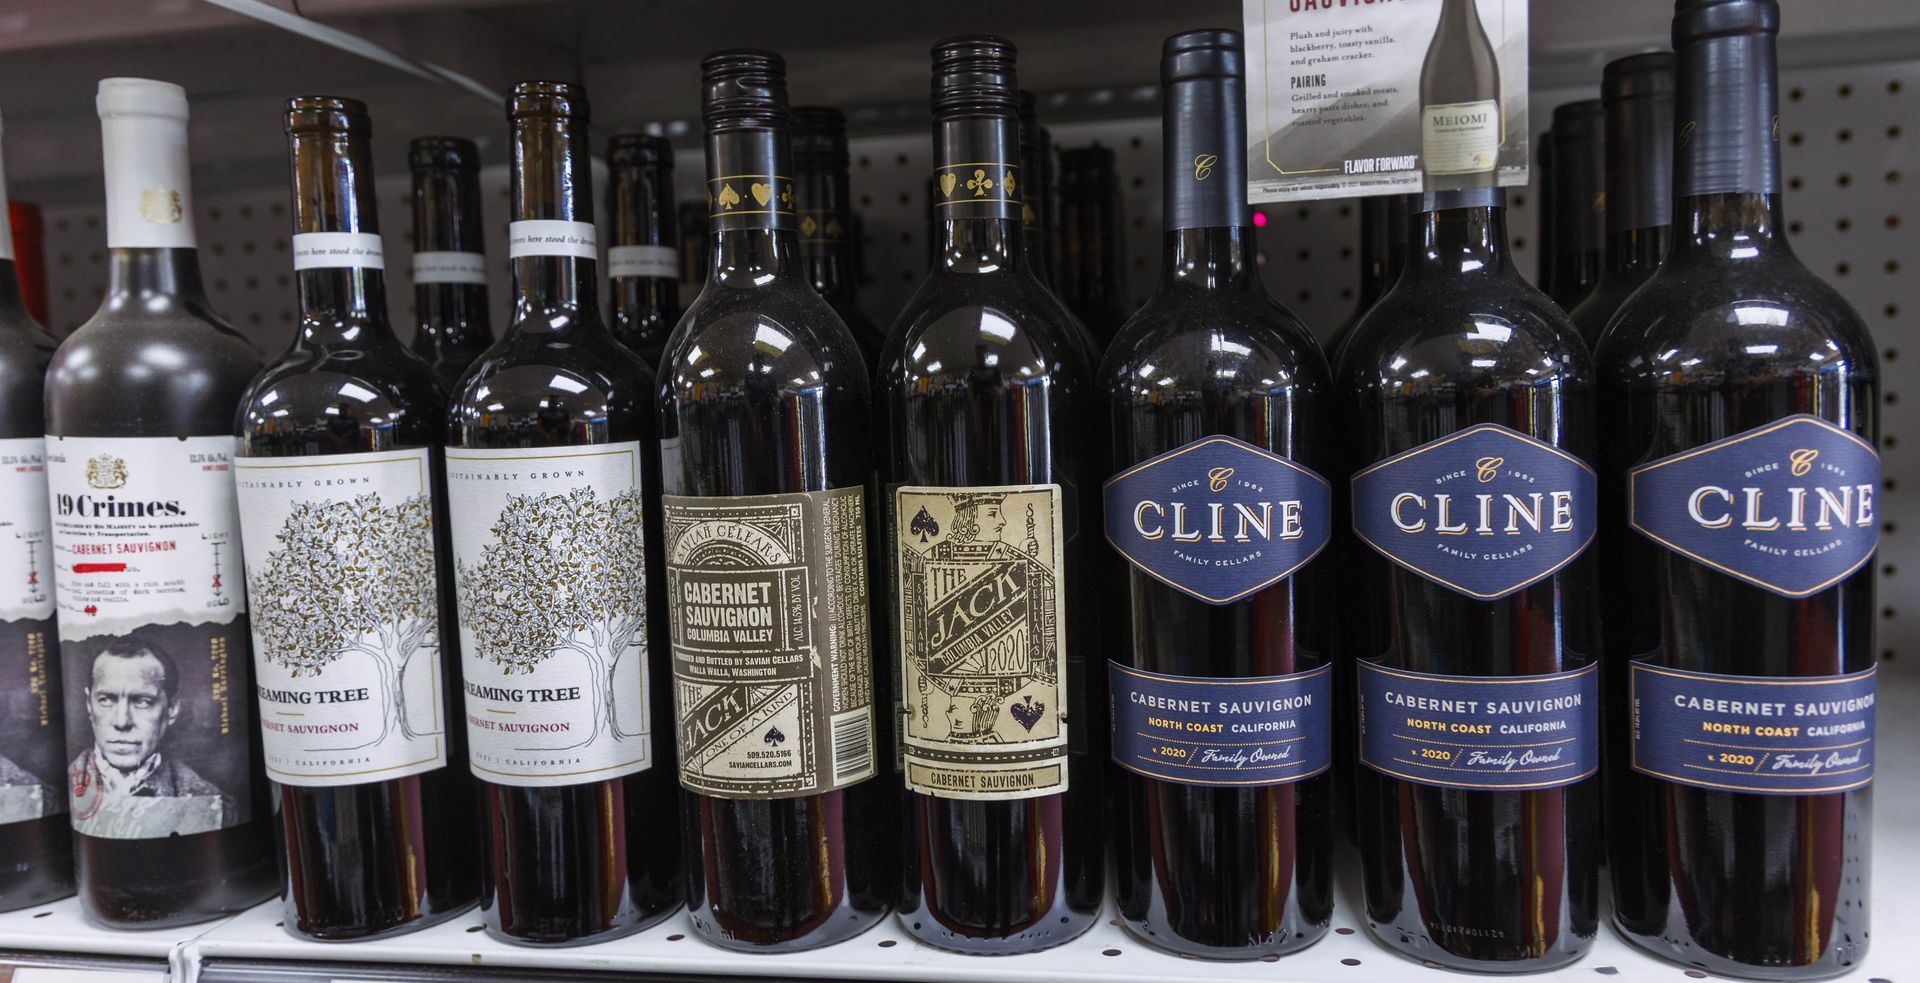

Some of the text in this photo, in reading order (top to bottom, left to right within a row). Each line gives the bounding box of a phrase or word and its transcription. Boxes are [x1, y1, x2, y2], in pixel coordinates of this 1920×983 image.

[1290, 25, 1373, 40] Plush and juicy with
[1339, 40, 1362, 49] toasty
[1290, 57, 1306, 66] and
[1308, 54, 1339, 66] graham
[1290, 74, 1327, 89] PAIRING
[1291, 92, 1321, 102] Grilled
[1323, 90, 1339, 99] and
[1340, 88, 1371, 98] smoked
[1291, 106, 1317, 115] hearty
[1319, 103, 1340, 114] pasta
[1372, 98, 1388, 107] and
[1292, 117, 1321, 127] roasted
[1433, 113, 1487, 127] MEIOMI
[1344, 158, 1374, 174] FLAVOR
[545, 235, 566, 243] stood
[530, 470, 584, 480] GROWN
[1436, 470, 1467, 485] SINCE
[1744, 462, 1779, 478] SINCE
[314, 477, 369, 487] GROWN
[1172, 479, 1200, 494] SINCE
[56, 493, 186, 518] 19 Crimes.
[1390, 491, 1575, 536] CLINE
[1687, 484, 1874, 531] CLINE
[1133, 500, 1304, 542] CLINE
[71, 540, 177, 555] CABERNET SAUVIGNON
[677, 526, 781, 563] SAVIAH CELLARS
[824, 526, 833, 556] SURGEON
[854, 494, 865, 597] CONTAINS SULFITES 750 ML
[1744, 539, 1843, 557] FAMILY CELLARS
[1174, 550, 1263, 567] FAMILY CELLARS
[1437, 543, 1534, 561] FAMILY CELLARS
[826, 568, 833, 577] TO
[684, 581, 771, 605] CABERNET
[930, 567, 967, 602] THE
[791, 593, 801, 604] BY
[827, 577, 836, 613] ACCORDING
[670, 576, 678, 639] 2021
[831, 497, 849, 711] WOMEN SHOULD NOT DRINK ALCOHOLIC BEVERAGES DURING PREGNANCY
[931, 564, 1021, 649] JACK
[685, 606, 772, 627] SAUVIGNON
[917, 583, 925, 652] SAVIAH
[1031, 577, 1040, 656] CELLARS
[686, 628, 773, 643] COLUMBIA VALLEY
[829, 624, 838, 662] WARNING:
[941, 608, 1015, 667] COLUMBIA VALLEY
[989, 627, 1025, 671] 2020
[695, 655, 705, 664] AND
[706, 656, 733, 666] BOTTLED
[734, 656, 744, 666] BY
[745, 655, 771, 666] SAVIAH
[772, 653, 804, 665] CELLARS
[689, 665, 777, 678] WALLA WALLA, WASHINGTON
[314, 688, 370, 704] TREE
[527, 687, 581, 703] TREE
[832, 663, 841, 712] GOVERNMENT
[680, 683, 703, 713] THE
[1130, 692, 1312, 714] CABERNET SAUVIGNON
[1385, 691, 1582, 715] CABERNET SAUVIGNON
[1674, 692, 1875, 717] CABERNET SAUVIGNON
[498, 722, 570, 733] SAUVIGNON
[684, 687, 743, 751] JACK
[705, 691, 793, 759] ONE OF A KIND
[1148, 717, 1297, 733] NORTH COAST CALIFORNIA
[1407, 717, 1567, 735] NORTH COAST CALIFORNIA
[287, 723, 359, 734] SAUVIGNON
[1702, 720, 1866, 737] NORTH COAST CALIFORNIA
[296, 757, 370, 766] CALIFORNIA
[506, 758, 581, 766] CALIFORNIA
[747, 750, 792, 760] 509.520.5166
[1161, 746, 1187, 758] 2020
[1201, 748, 1248, 771] Family
[1250, 745, 1292, 763] Owned
[1421, 748, 1451, 761] 2020
[1466, 751, 1518, 772] Family
[1519, 747, 1562, 767] Owned
[1719, 752, 1755, 765] 2020
[1772, 754, 1825, 775] Family
[1825, 749, 1862, 769] Owned
[728, 760, 793, 770] SAVIAHCELLARS.COM
[931, 772, 1034, 788] CABERNET SAUVIGNON
